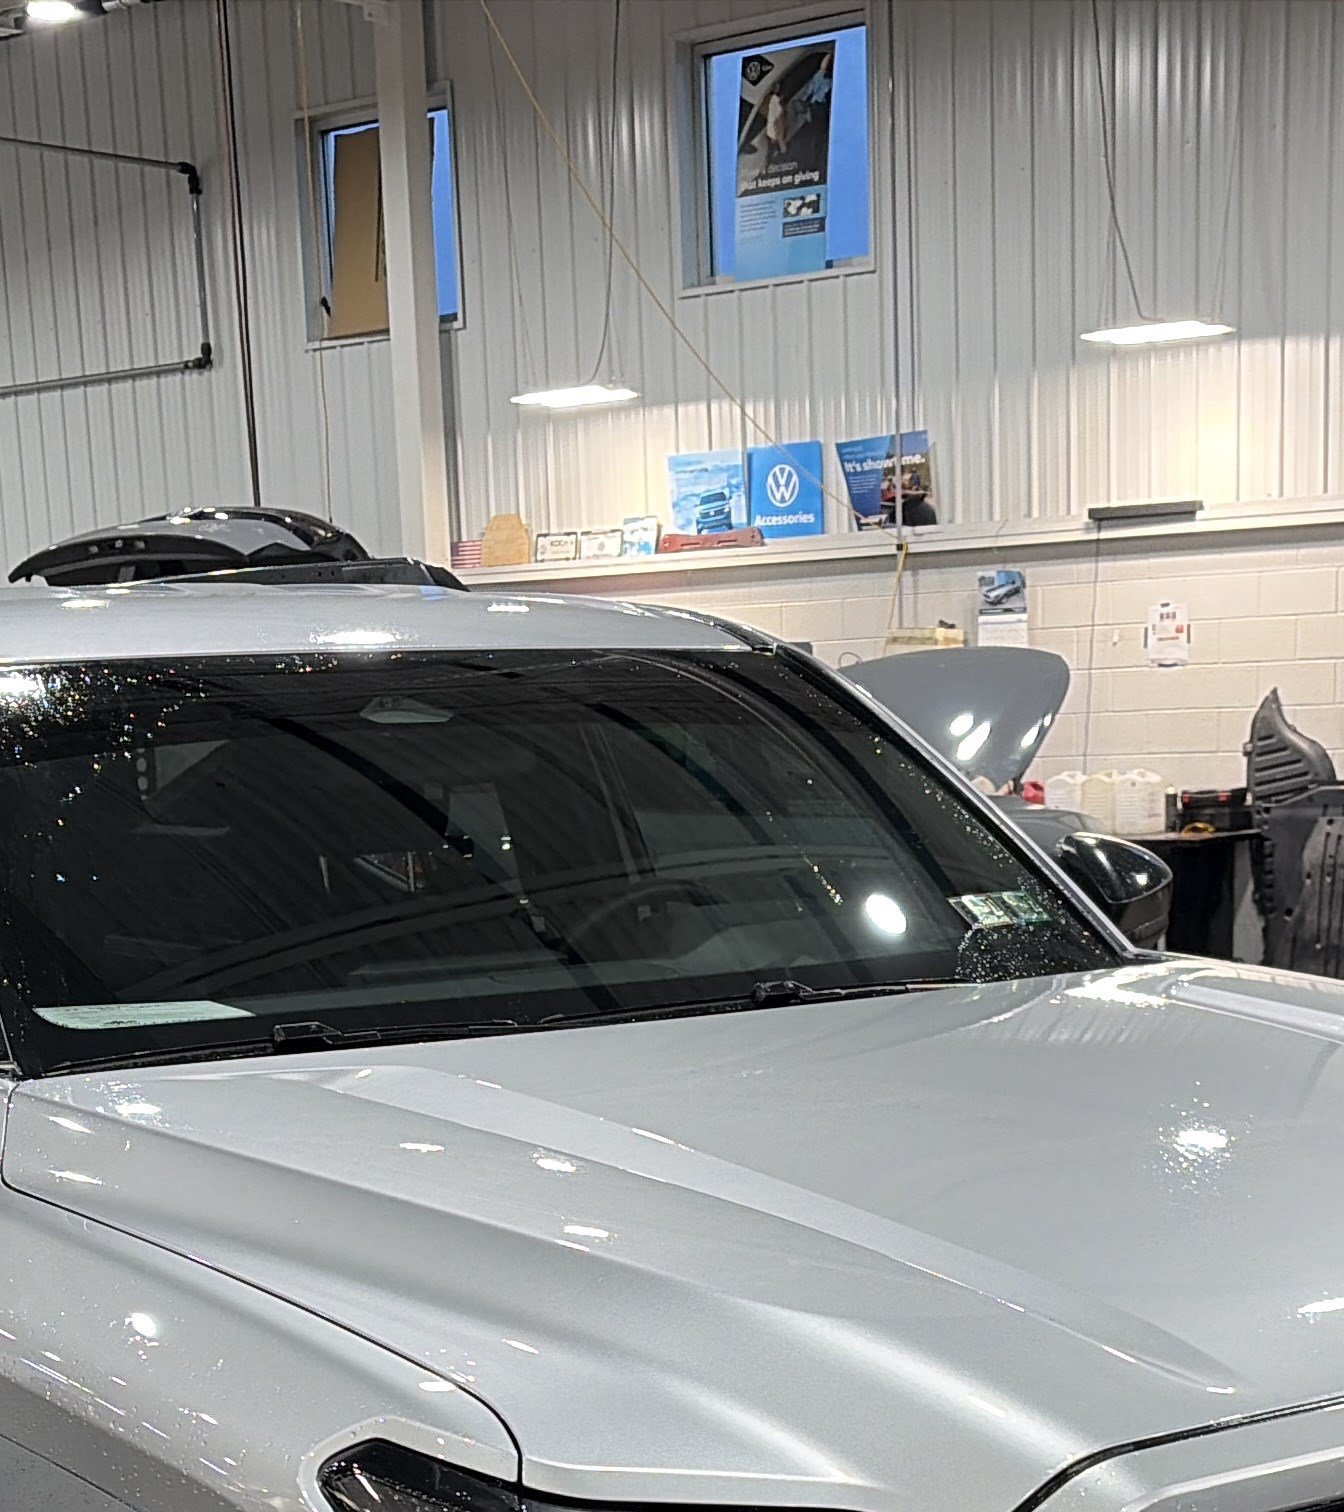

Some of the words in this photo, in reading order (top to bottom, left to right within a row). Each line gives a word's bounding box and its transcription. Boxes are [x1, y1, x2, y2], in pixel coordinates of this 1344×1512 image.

[793, 170, 820, 185] giving
[843, 460, 862, 473] It's
[754, 511, 815, 527] Accessories
